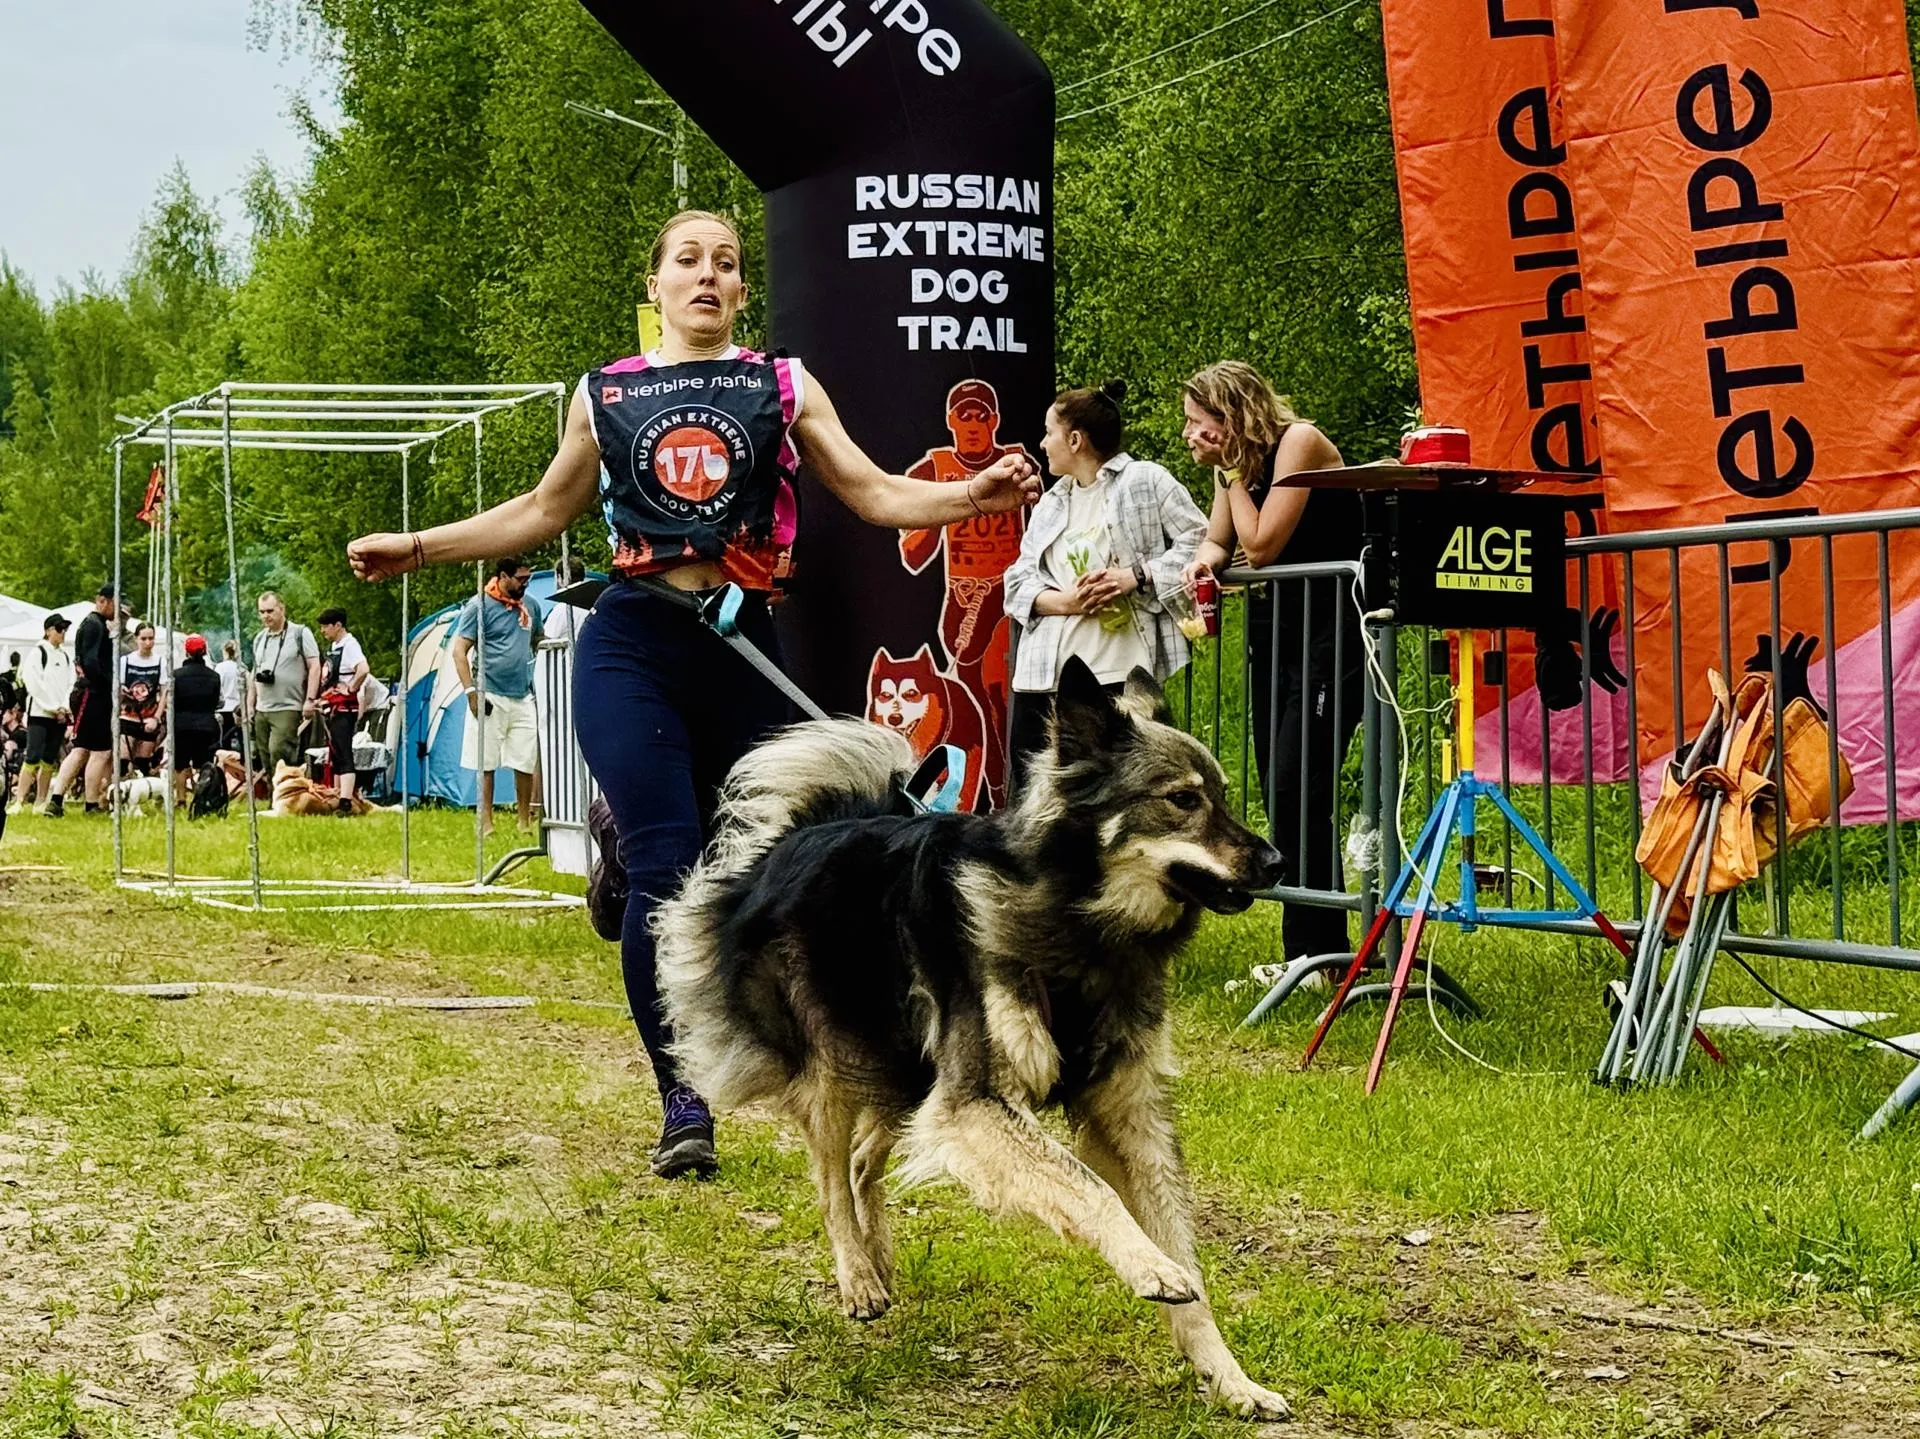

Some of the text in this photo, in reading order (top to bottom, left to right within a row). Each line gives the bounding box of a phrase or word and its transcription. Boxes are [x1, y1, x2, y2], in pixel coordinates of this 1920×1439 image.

[869, 0, 961, 76] ре
[855, 173, 1041, 215] RUSSIAN
[847, 221, 1045, 263] EXTREME
[911, 268, 1009, 305] DOG
[897, 315, 1028, 354] TRAIL
[627, 374, 762, 398] четыре лапы
[639, 412, 746, 470] RUSSIAN EXTREME
[659, 491, 736, 516] DOG TRAIL
[1436, 525, 1532, 574] ALGE
[1444, 574, 1526, 591] TIMING
